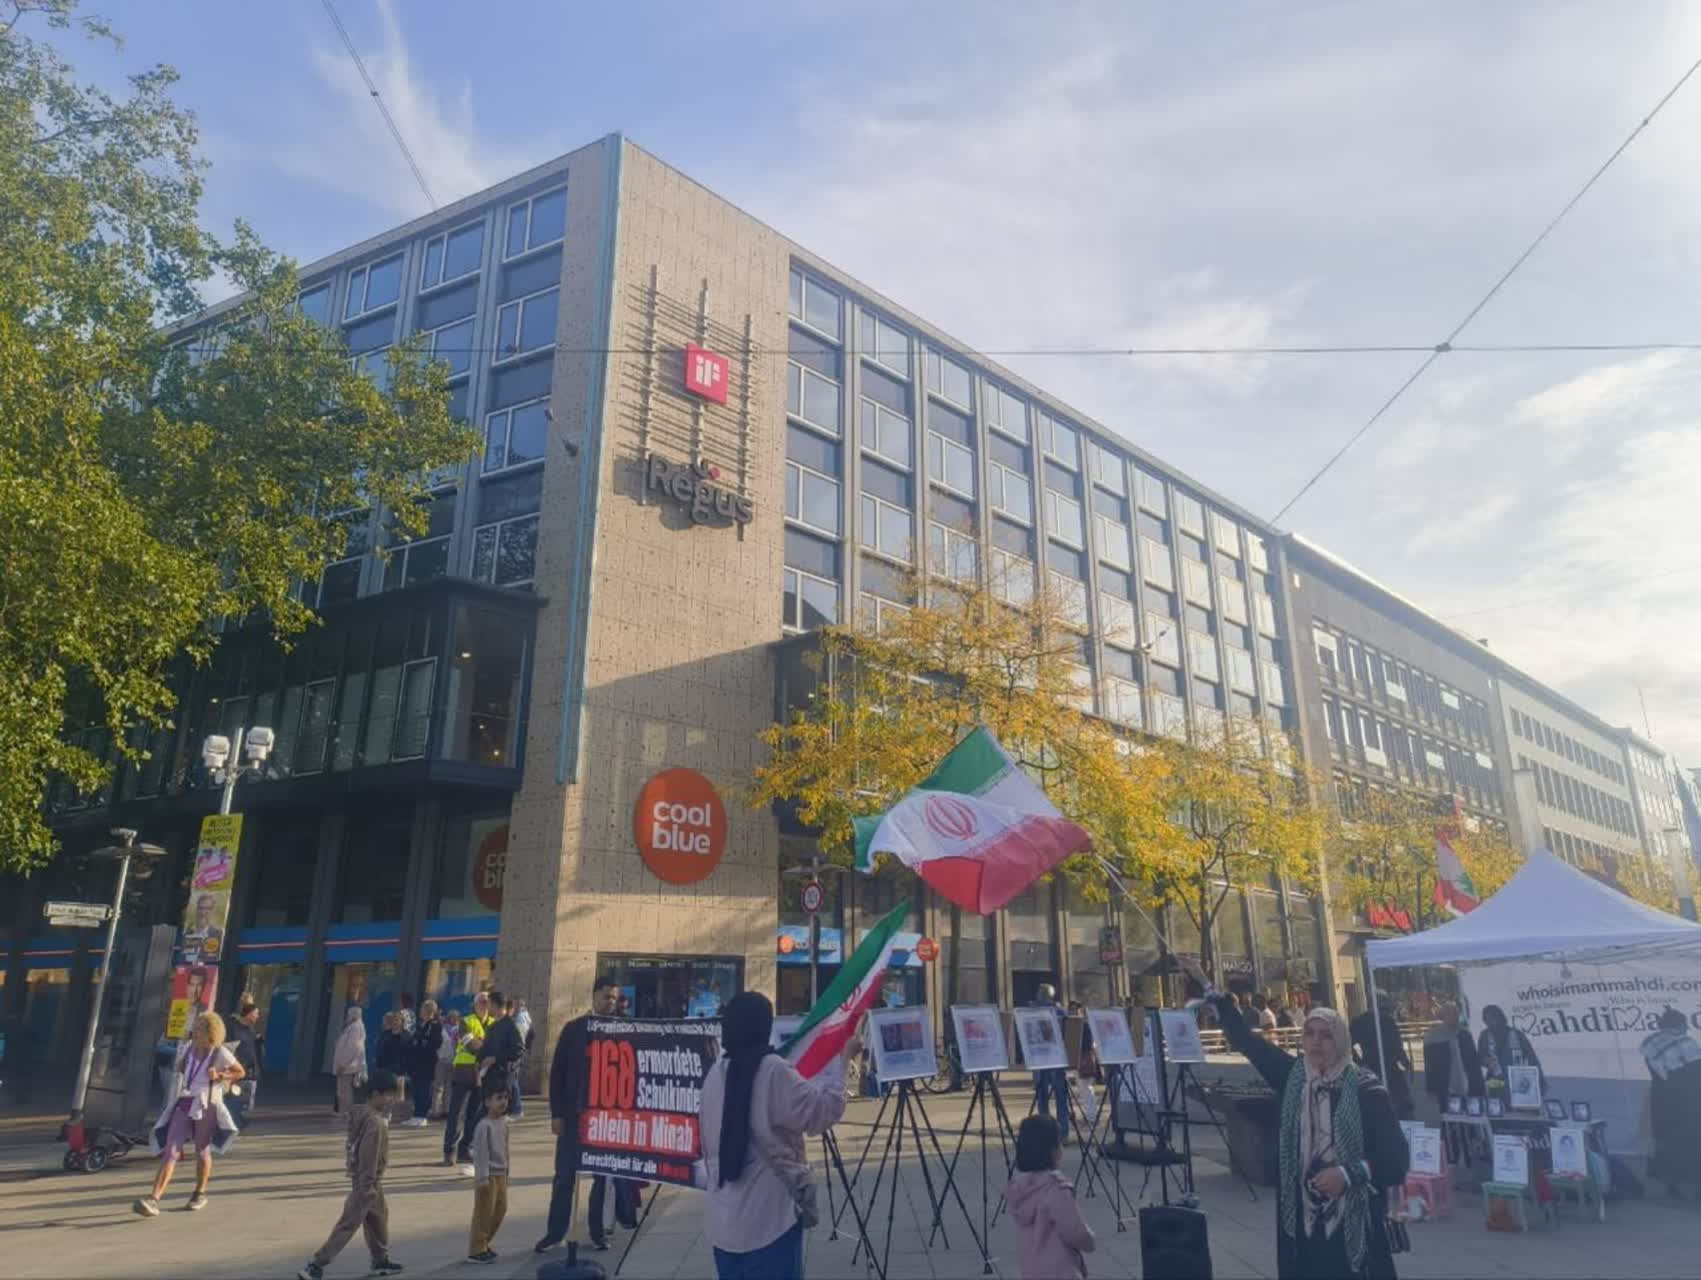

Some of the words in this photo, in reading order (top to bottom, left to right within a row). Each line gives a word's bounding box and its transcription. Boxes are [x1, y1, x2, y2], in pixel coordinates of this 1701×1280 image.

[649, 454, 753, 523] Regus
[653, 801, 711, 828] cool
[652, 821, 711, 854] blue
[587, 1041, 636, 1108] 168
[637, 1045, 702, 1077] ermordete
[637, 1077, 701, 1113] Schulkinde
[587, 1111, 631, 1145] allein
[633, 1113, 647, 1147] in
[650, 1115, 693, 1152] Minab
[581, 1152, 631, 1171] Gerechtigkeit
